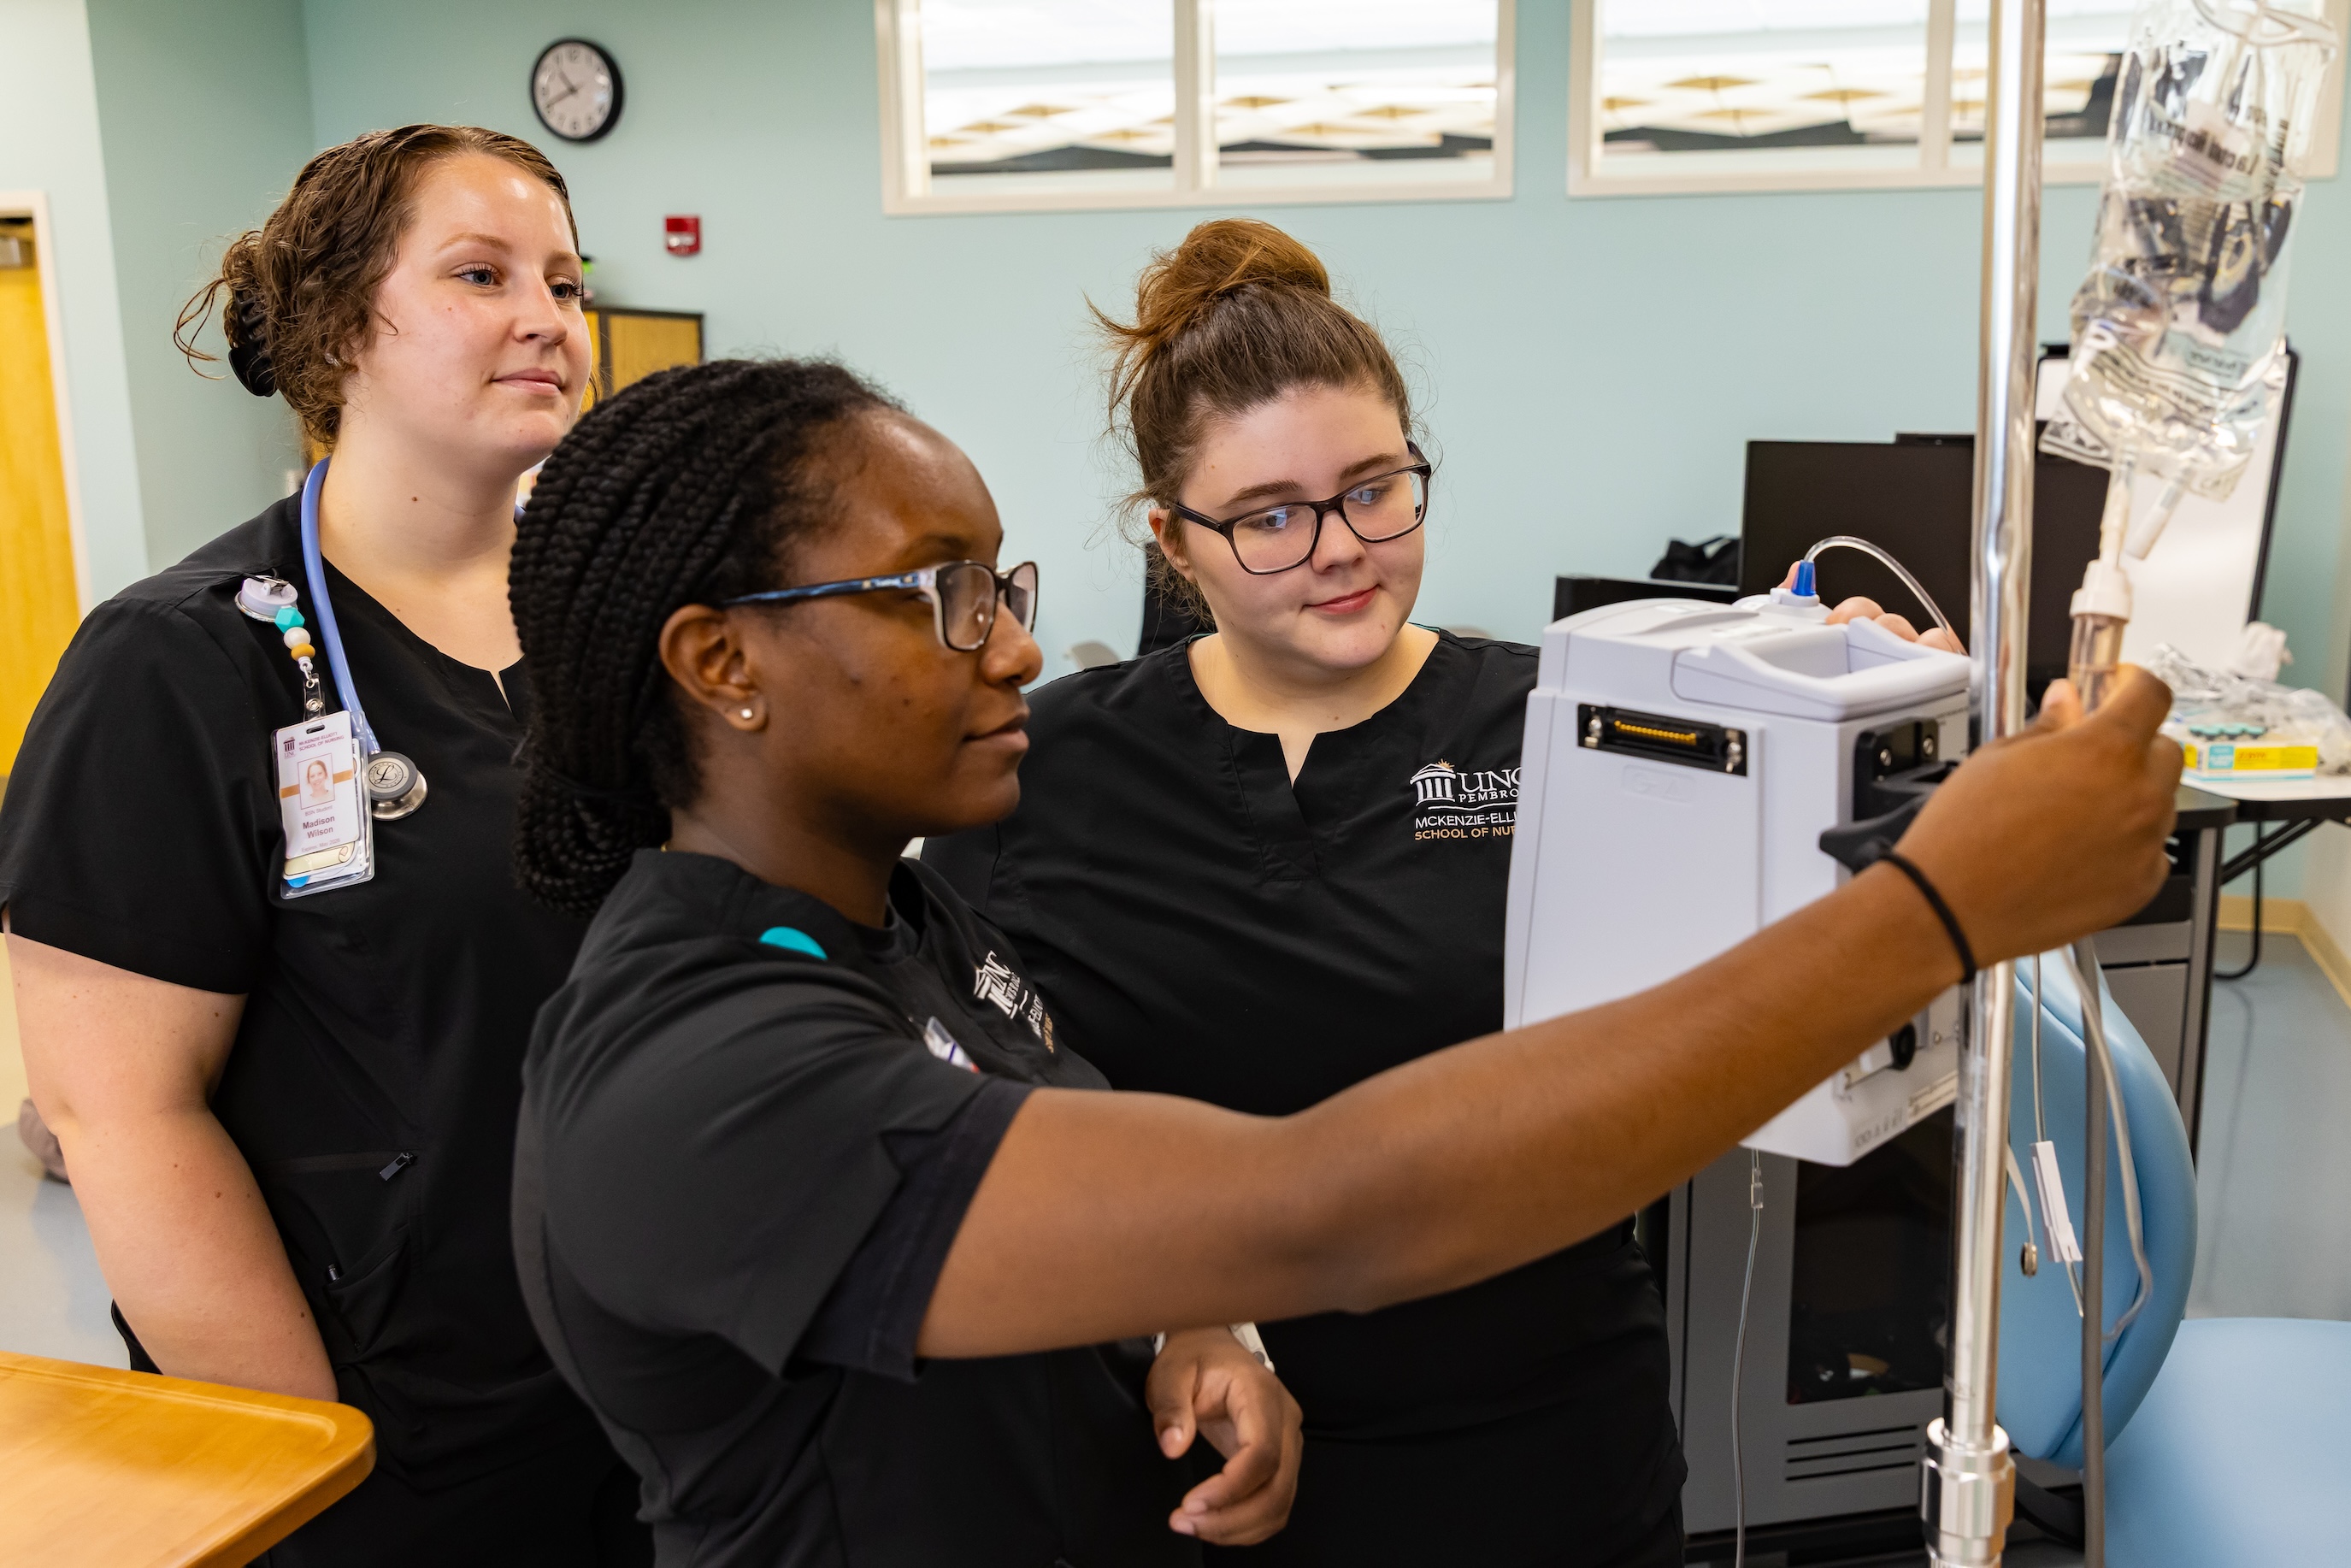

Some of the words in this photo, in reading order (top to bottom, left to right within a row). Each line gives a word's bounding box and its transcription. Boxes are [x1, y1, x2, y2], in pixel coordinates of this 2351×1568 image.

[303, 816, 335, 829] Madison
[307, 827, 333, 839] Wilson
[1415, 828, 1468, 840] SCHOOL
[1470, 828, 1489, 839] OF
